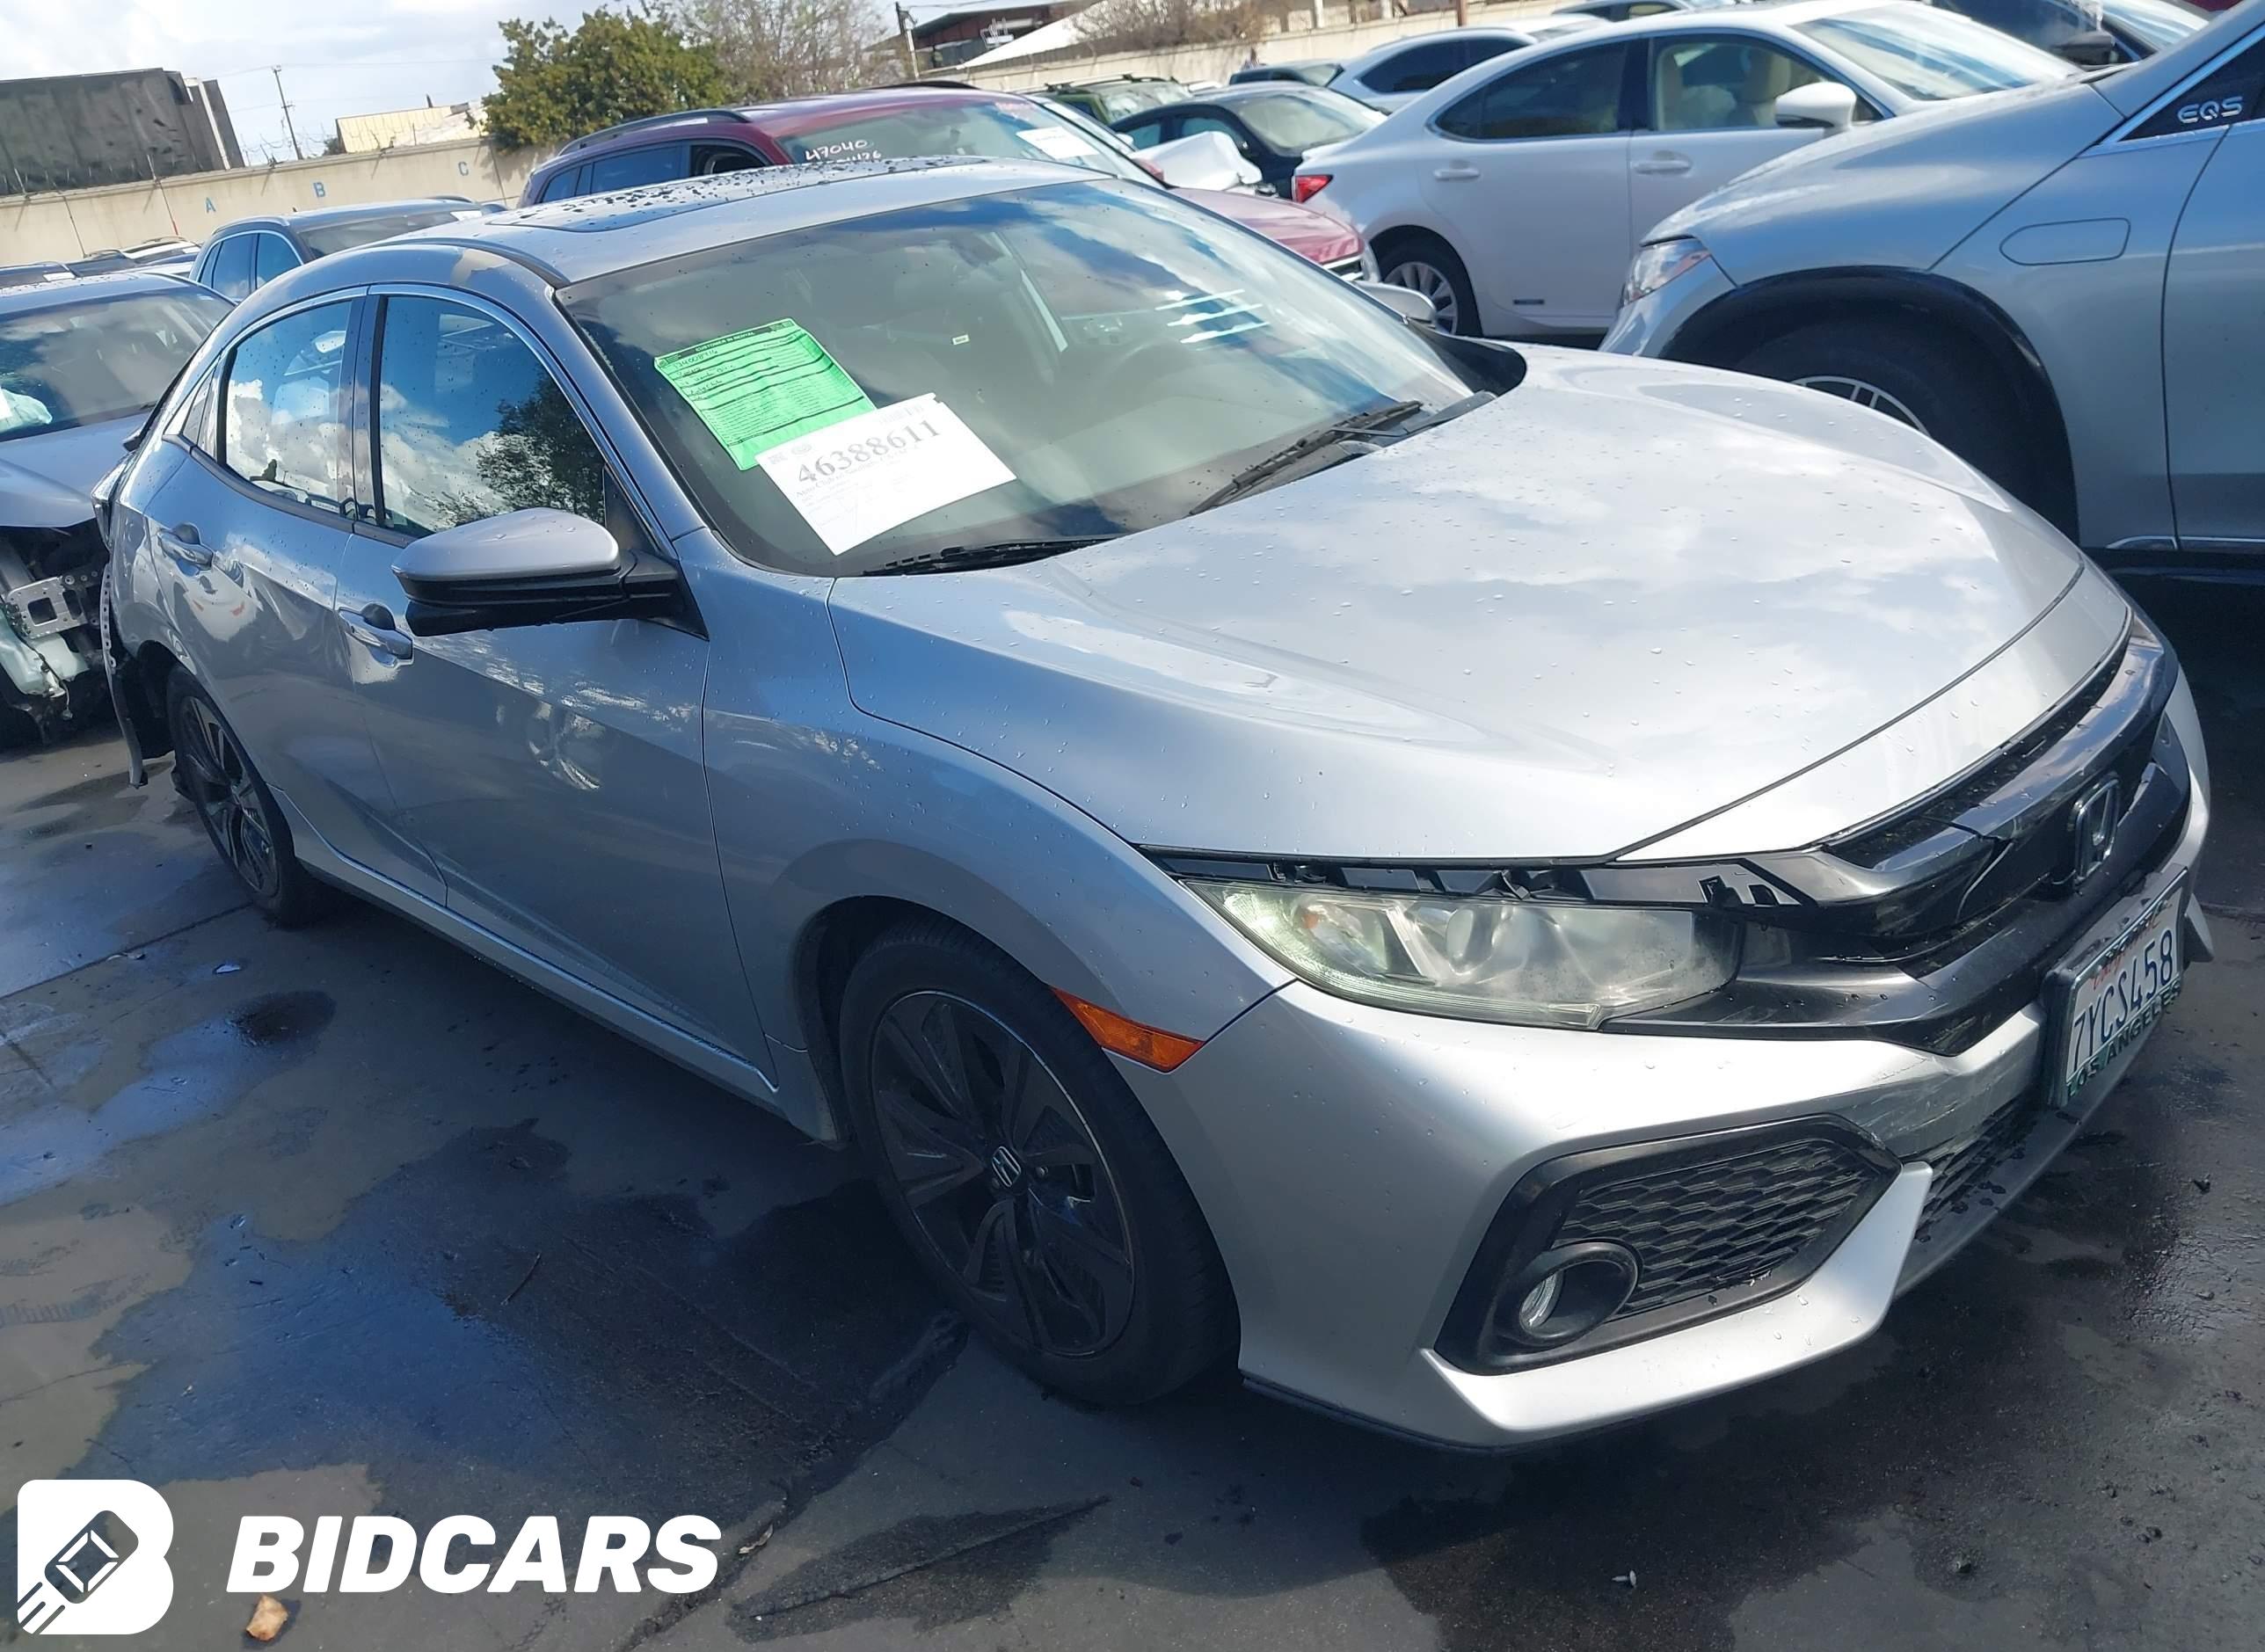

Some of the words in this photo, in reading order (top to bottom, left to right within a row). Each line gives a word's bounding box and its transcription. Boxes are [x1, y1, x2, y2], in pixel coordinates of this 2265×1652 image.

[2177, 96, 2243, 124] EQS
[805, 140, 868, 160] 47040
[458, 161, 470, 177] C
[313, 181, 326, 199] B
[205, 196, 216, 214] A
[799, 421, 939, 481] 46388611
[2073, 928, 2174, 1073] 7YCS458
[2107, 979, 2181, 1062] ANGELES
